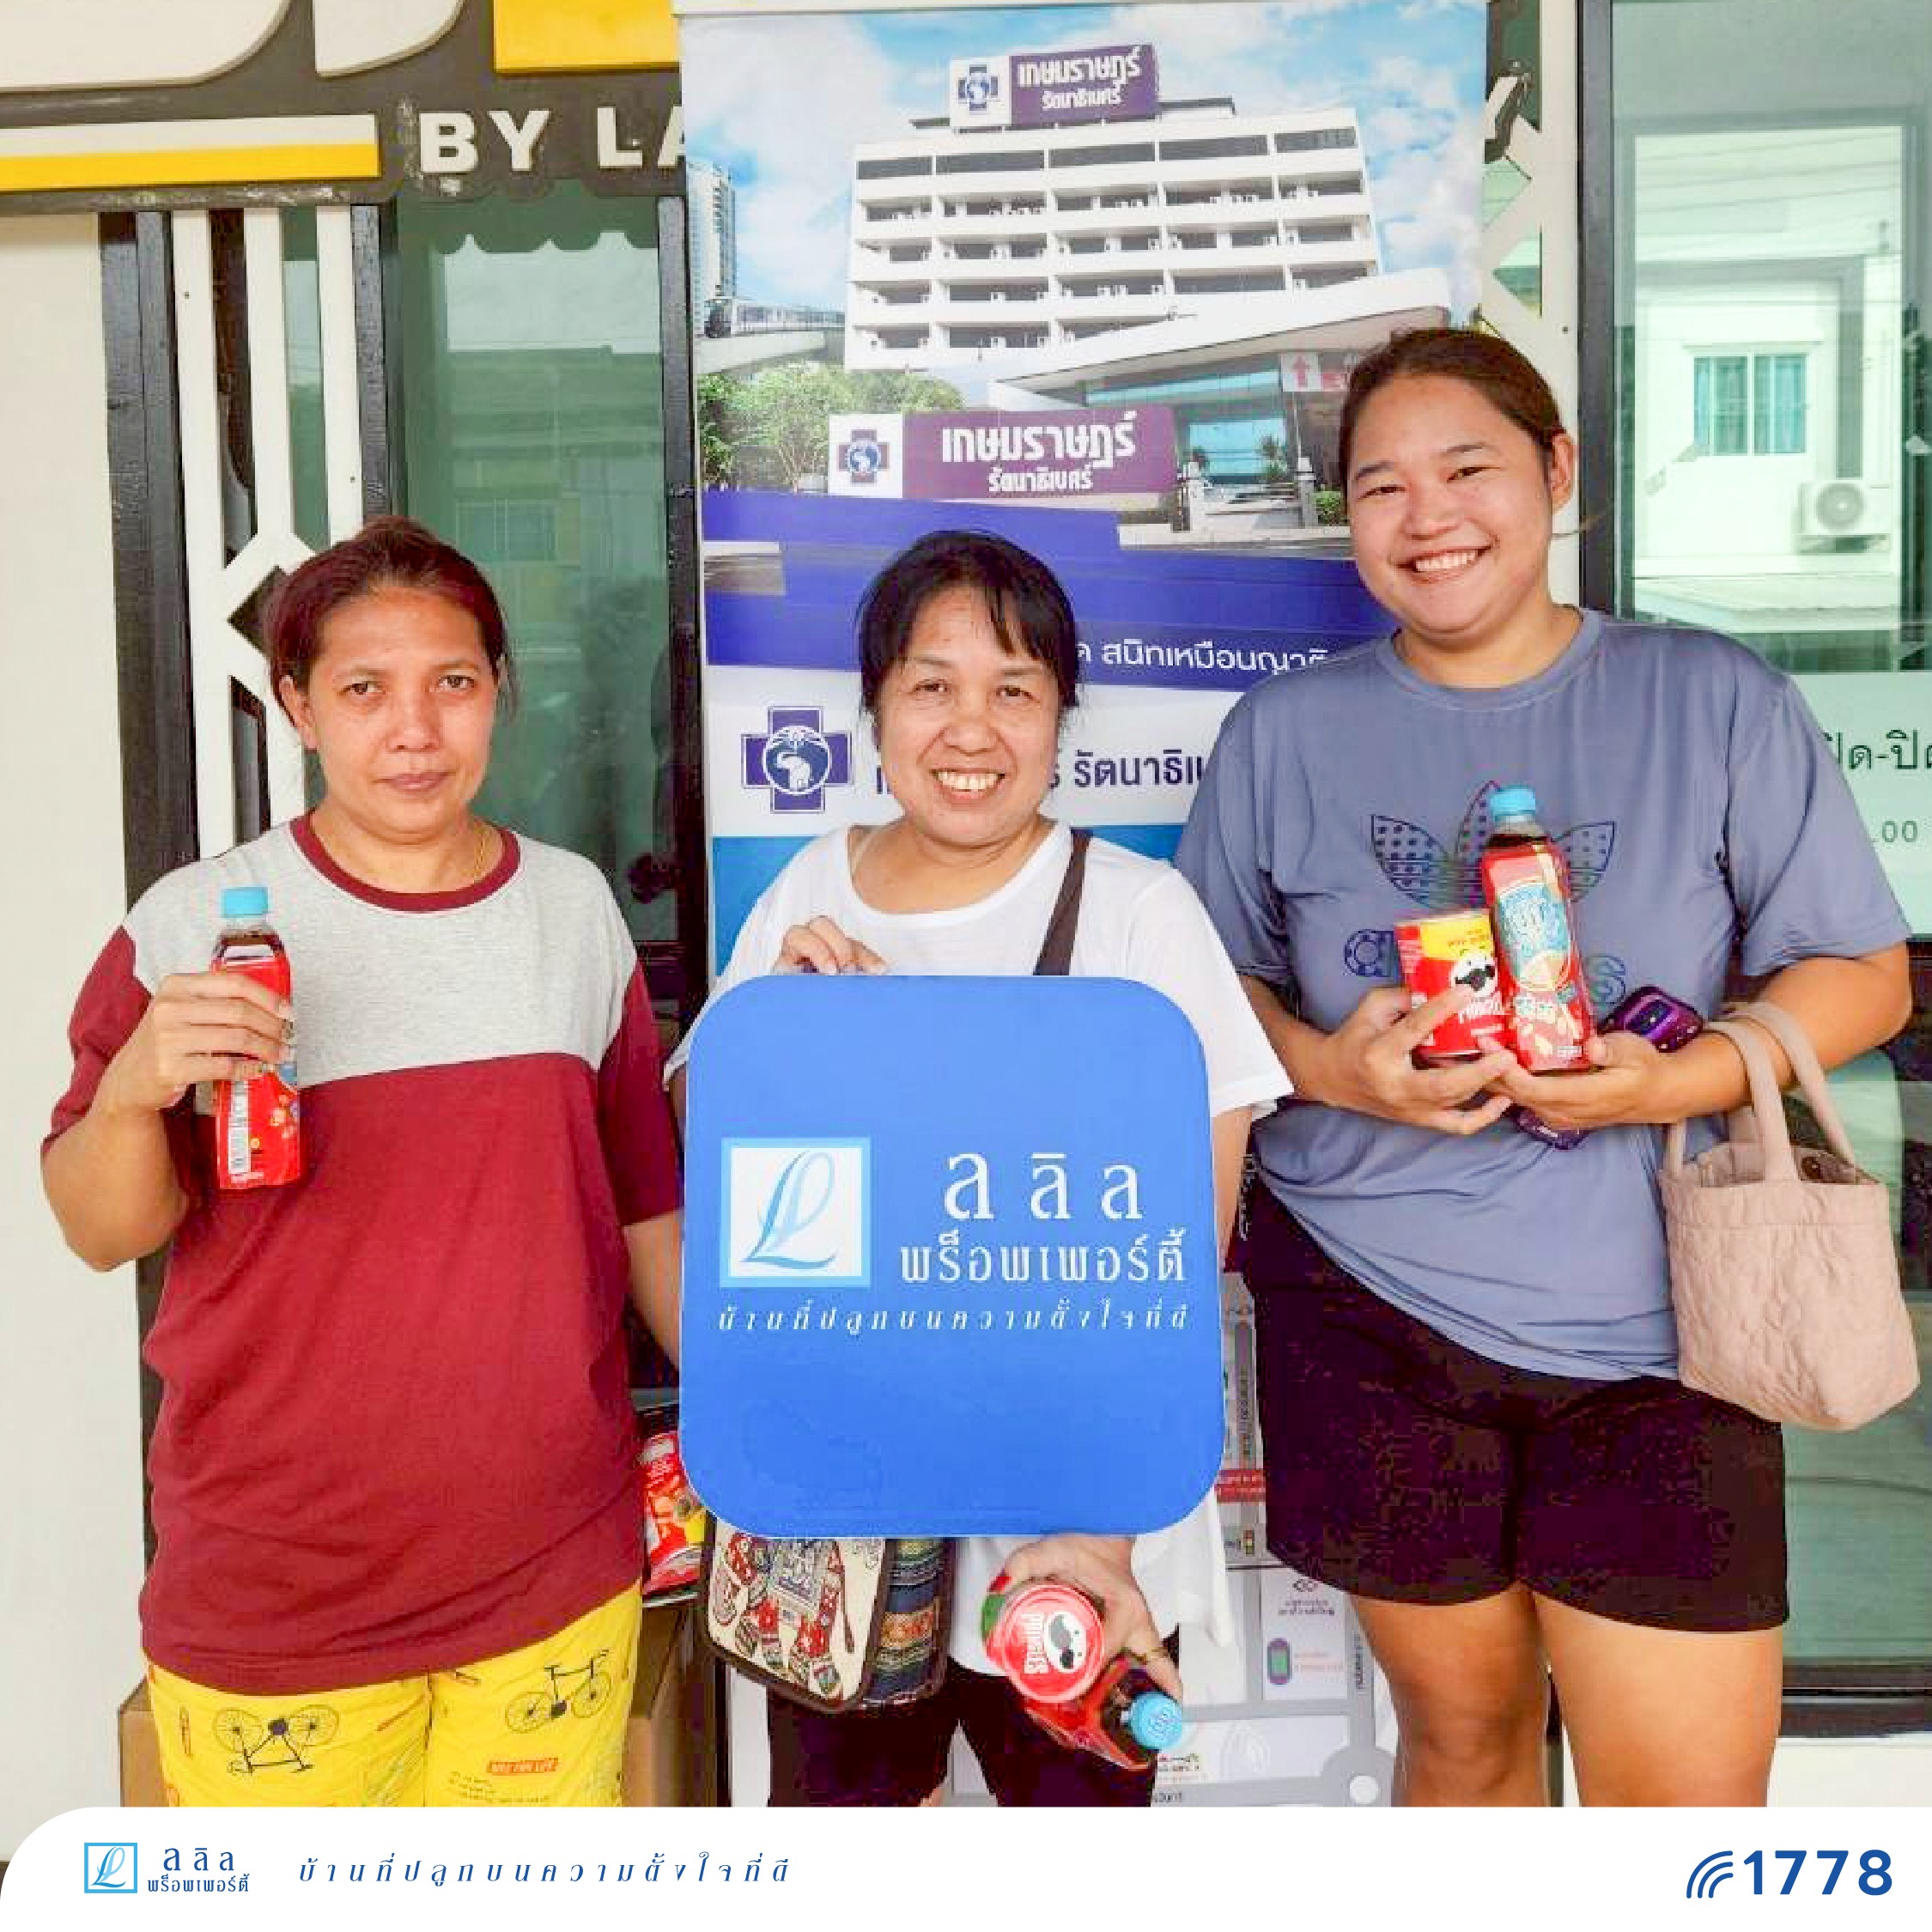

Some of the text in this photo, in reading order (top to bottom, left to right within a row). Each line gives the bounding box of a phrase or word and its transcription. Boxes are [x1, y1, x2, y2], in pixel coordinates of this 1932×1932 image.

[420, 110, 550, 173] BY
[942, 410, 1137, 469] เกษมราษฎร์
[988, 465, 1093, 492] รัตนาธิเบศร์
[1074, 749, 1203, 787] รัตนาธิเ
[944, 1152, 1144, 1220] ลลิล
[900, 1227, 1188, 1283] พร็อพเพอร์ตี้
